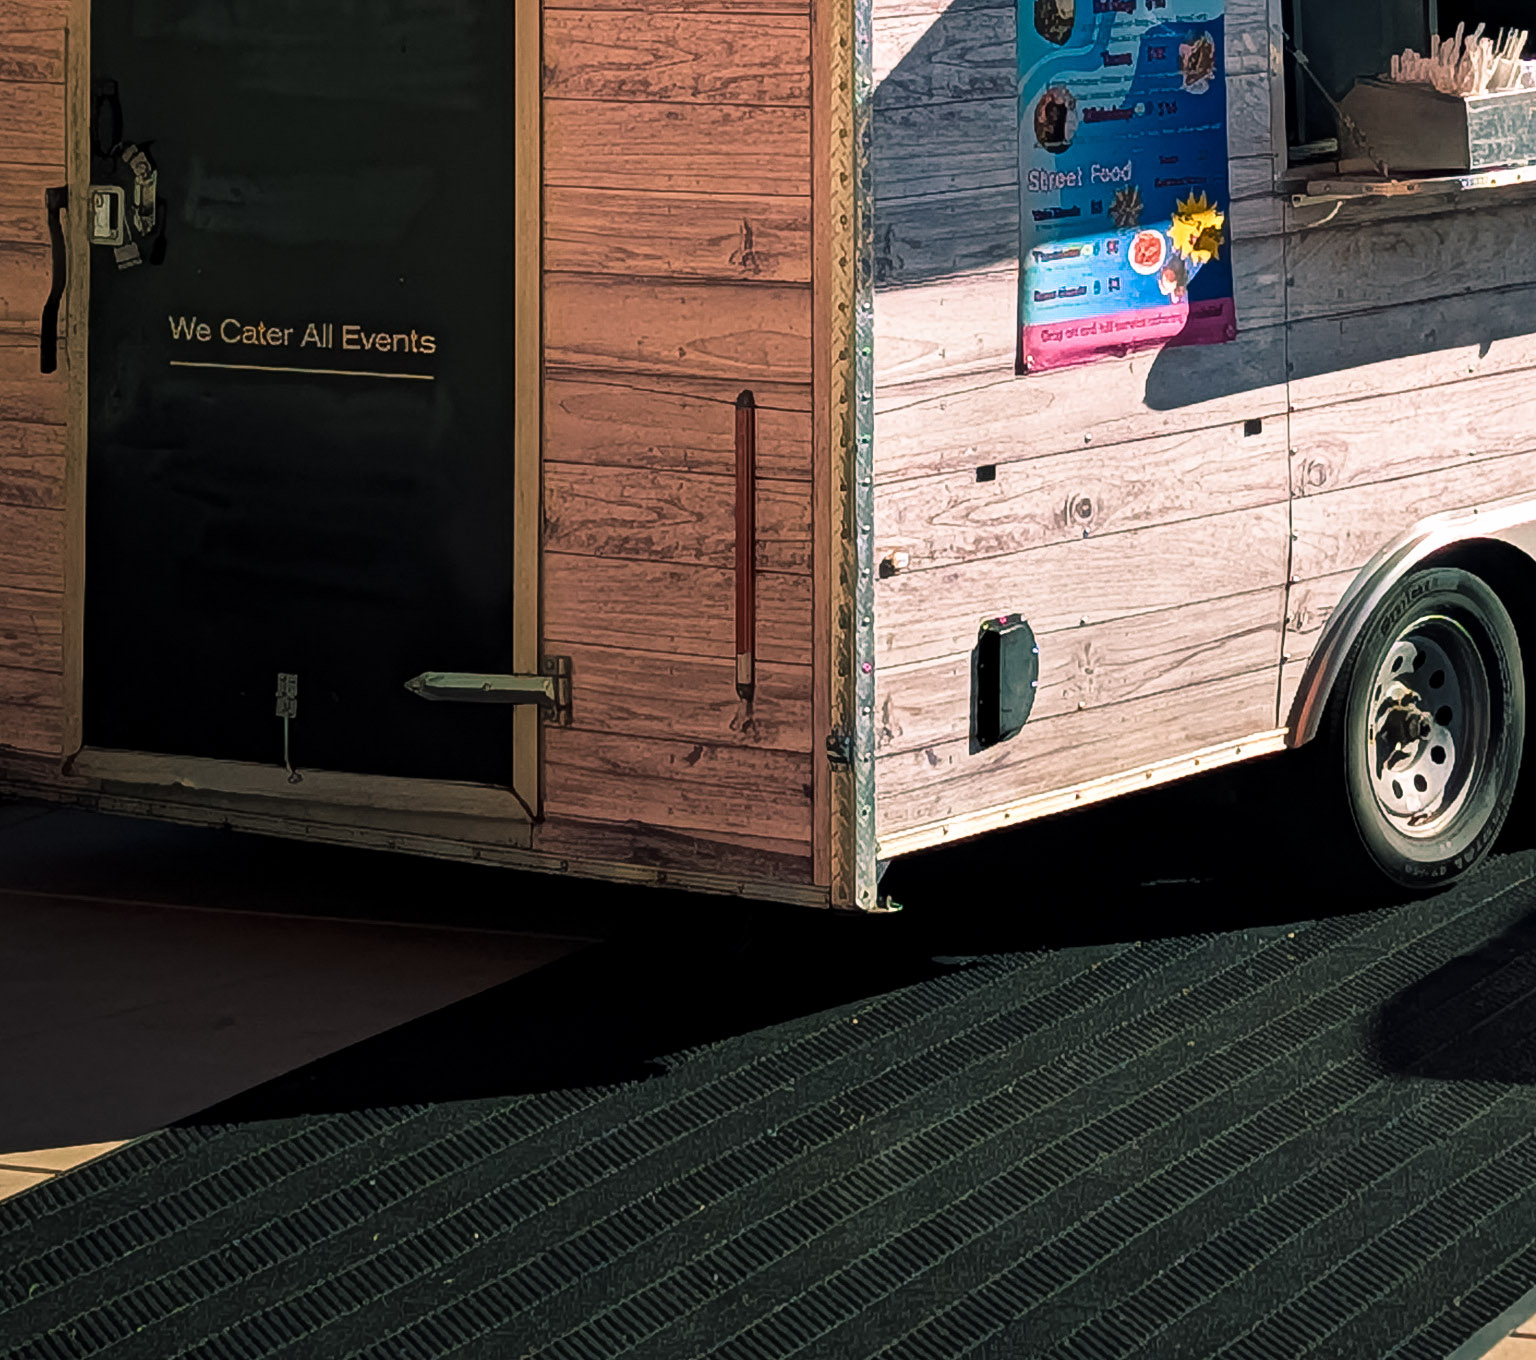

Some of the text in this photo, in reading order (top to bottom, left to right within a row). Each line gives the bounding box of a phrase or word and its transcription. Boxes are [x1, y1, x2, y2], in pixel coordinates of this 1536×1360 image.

[1027, 166, 1083, 192] Street
[1090, 160, 1133, 184] Food
[168, 315, 438, 355] We Cater All Events
